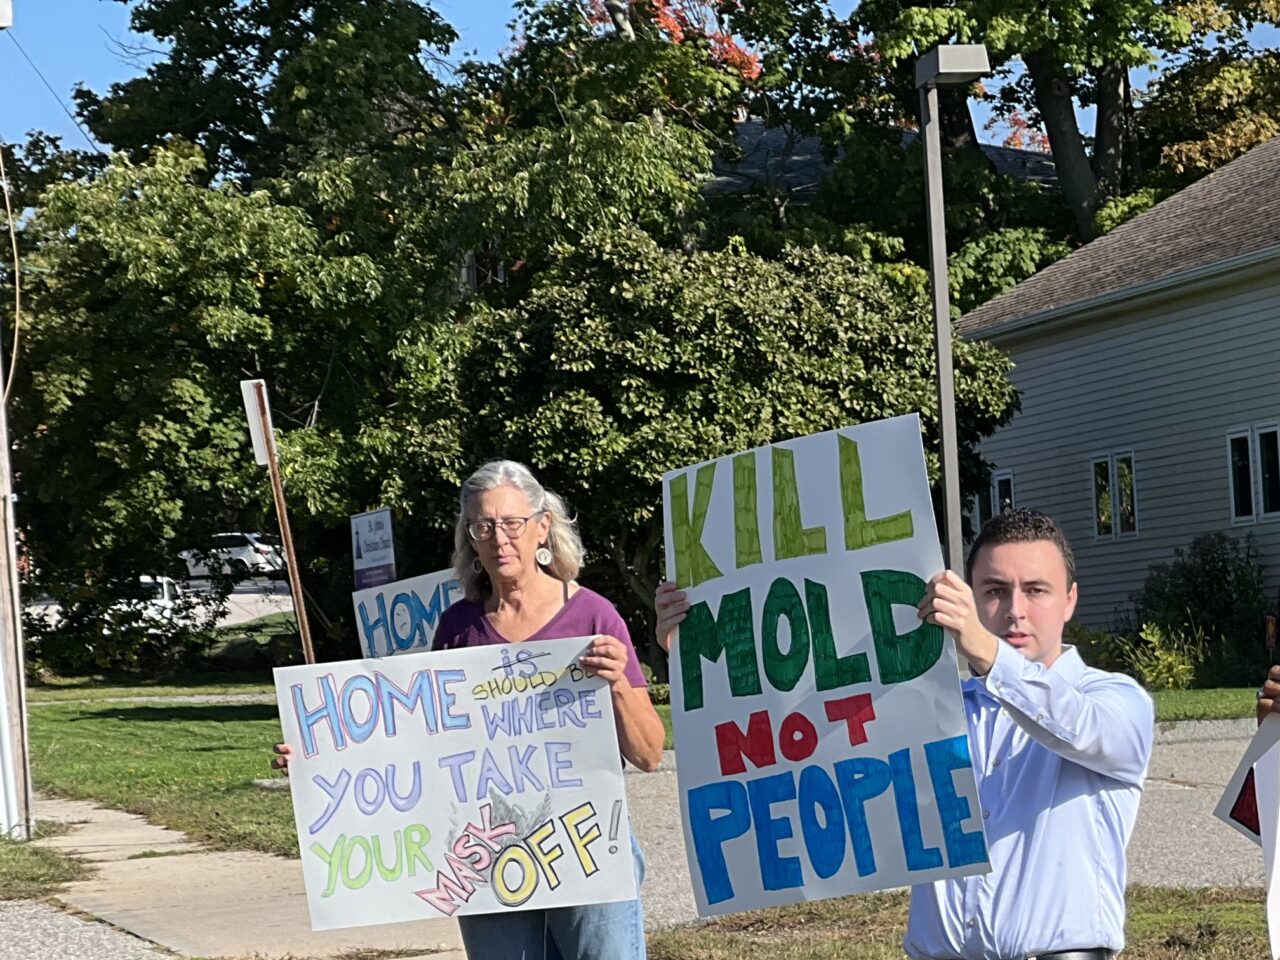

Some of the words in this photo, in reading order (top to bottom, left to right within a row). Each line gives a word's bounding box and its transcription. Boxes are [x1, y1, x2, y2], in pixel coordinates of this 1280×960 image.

[669, 434, 914, 588] KILL
[472, 671, 557, 700] SHOULD
[679, 569, 944, 711] MOLD
[290, 669, 472, 759] HOME
[481, 688, 602, 741] WHERE
[714, 693, 876, 776] NOT
[309, 761, 422, 835] YOU
[438, 742, 583, 803] TAKE
[687, 735, 988, 905] PEOPLE
[309, 823, 435, 898] YOUR
[414, 803, 517, 917] MASK
[491, 800, 623, 907] OFF!
